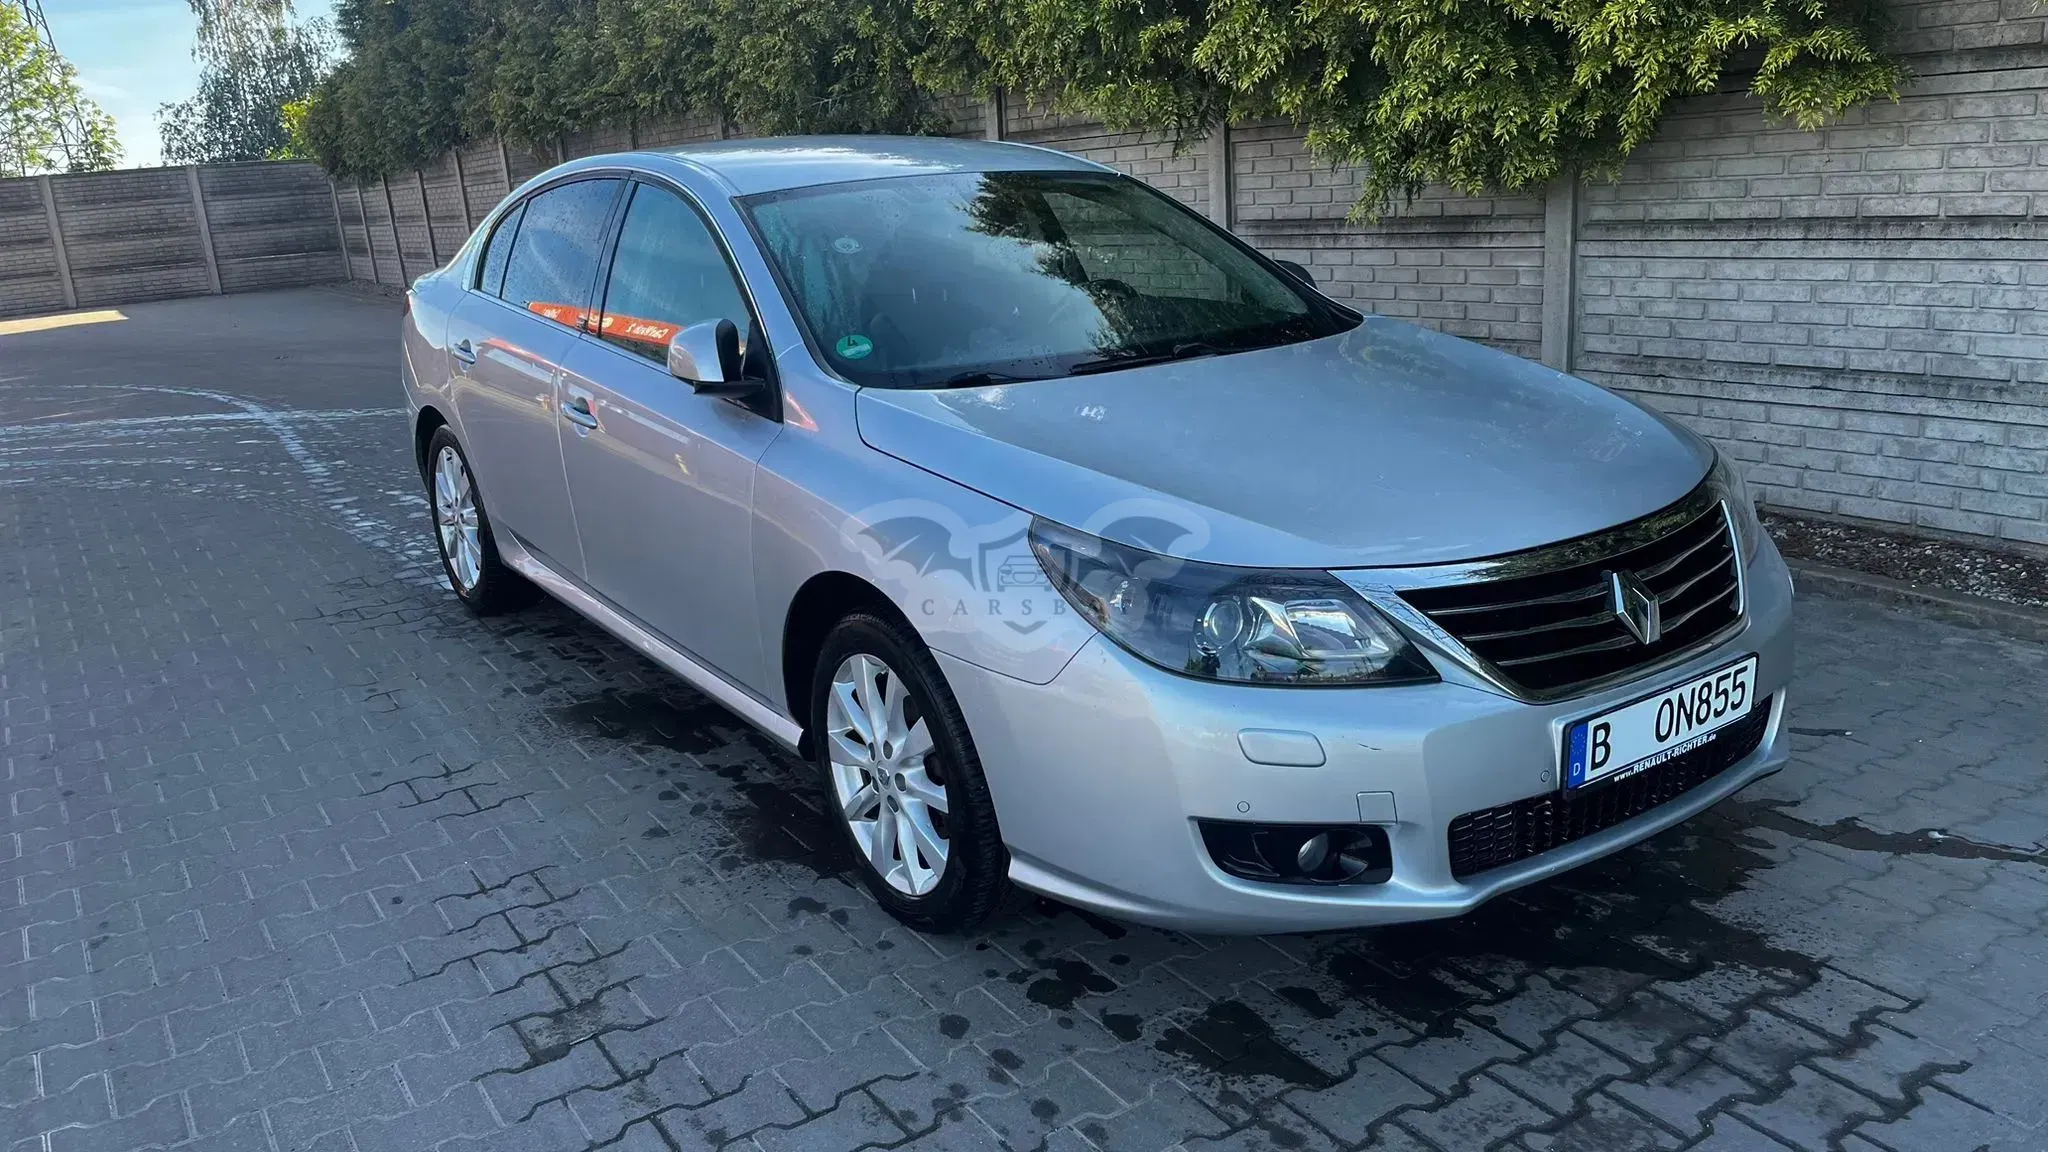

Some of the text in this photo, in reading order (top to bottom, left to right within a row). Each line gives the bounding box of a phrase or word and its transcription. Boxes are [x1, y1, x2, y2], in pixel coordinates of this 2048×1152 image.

[847, 336, 858, 347] 4
[1590, 665, 1748, 771] B ON855
[1572, 762, 1581, 777] D
[1613, 733, 1717, 782] www.RENAULT-RICHTER.de
